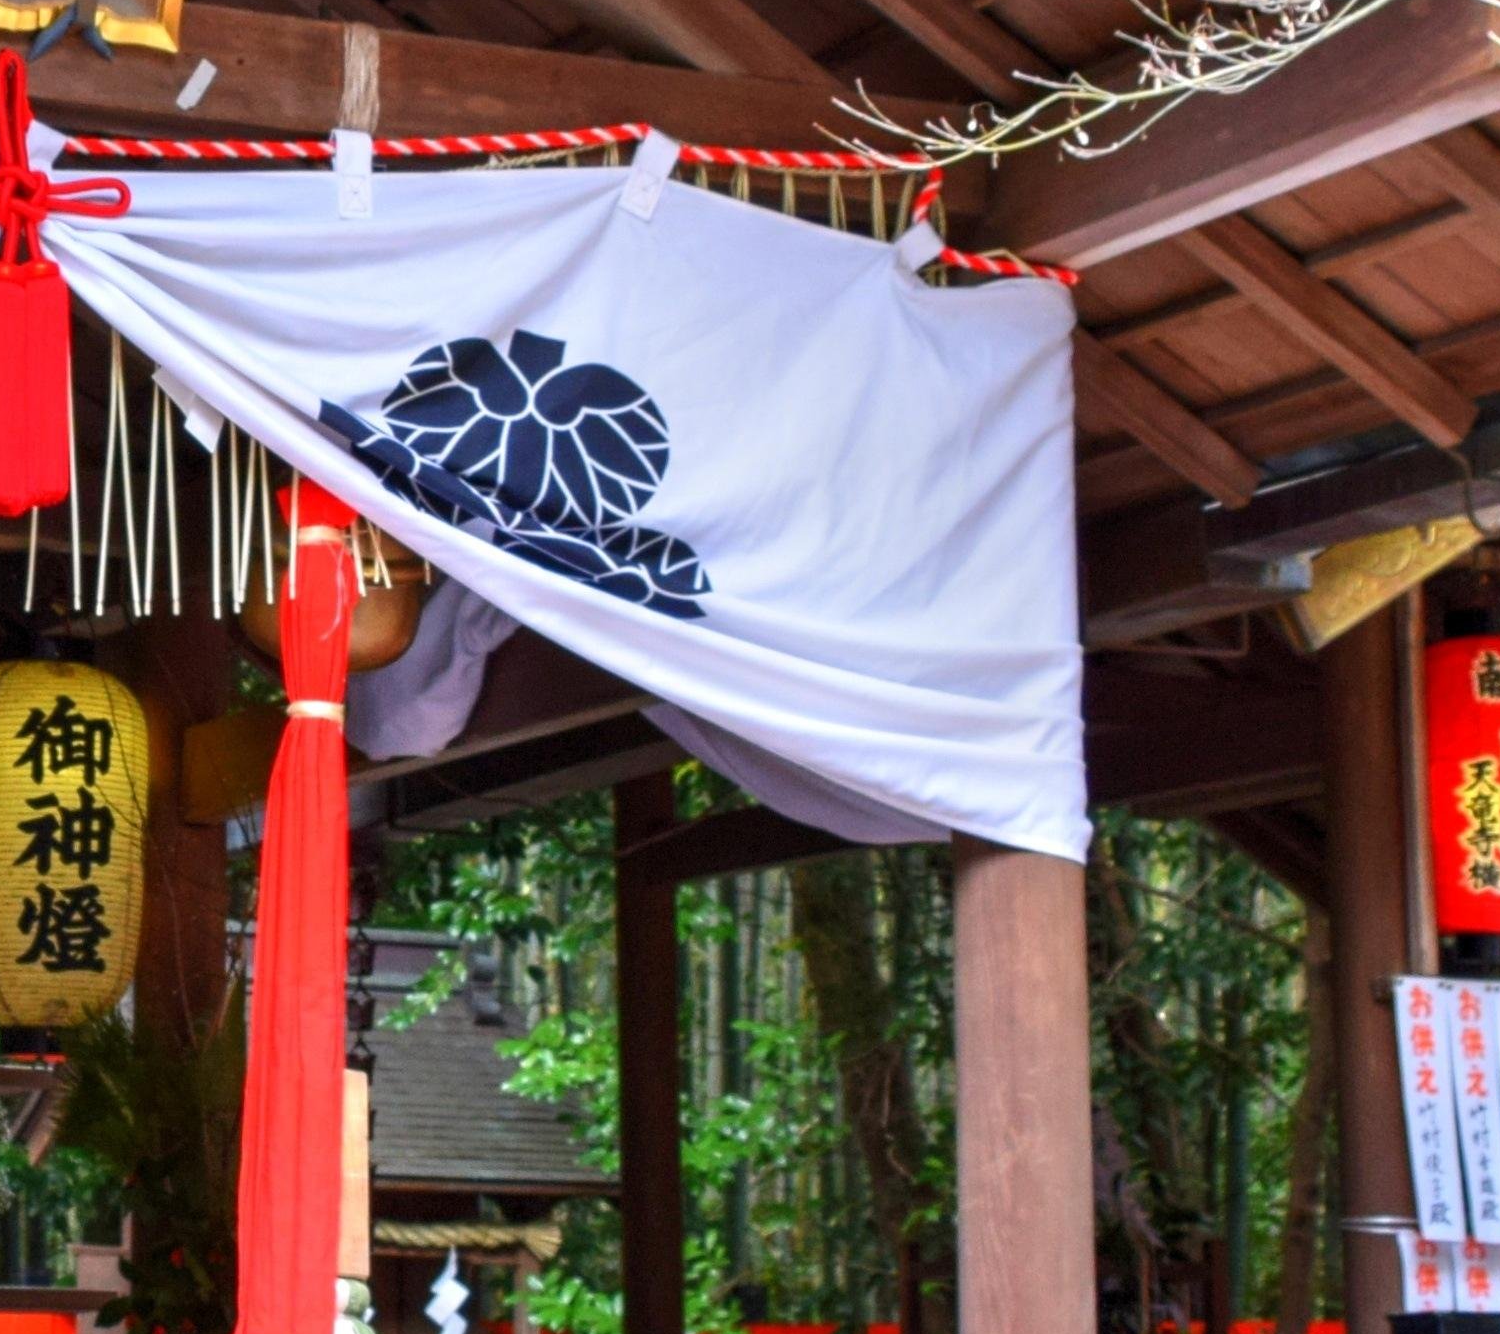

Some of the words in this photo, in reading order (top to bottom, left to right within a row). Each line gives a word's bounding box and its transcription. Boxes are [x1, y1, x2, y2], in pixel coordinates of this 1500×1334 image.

[11, 694, 115, 974] 御神燈
[1415, 1237, 1440, 1295] お供
[1463, 1237, 1491, 1297] お供
